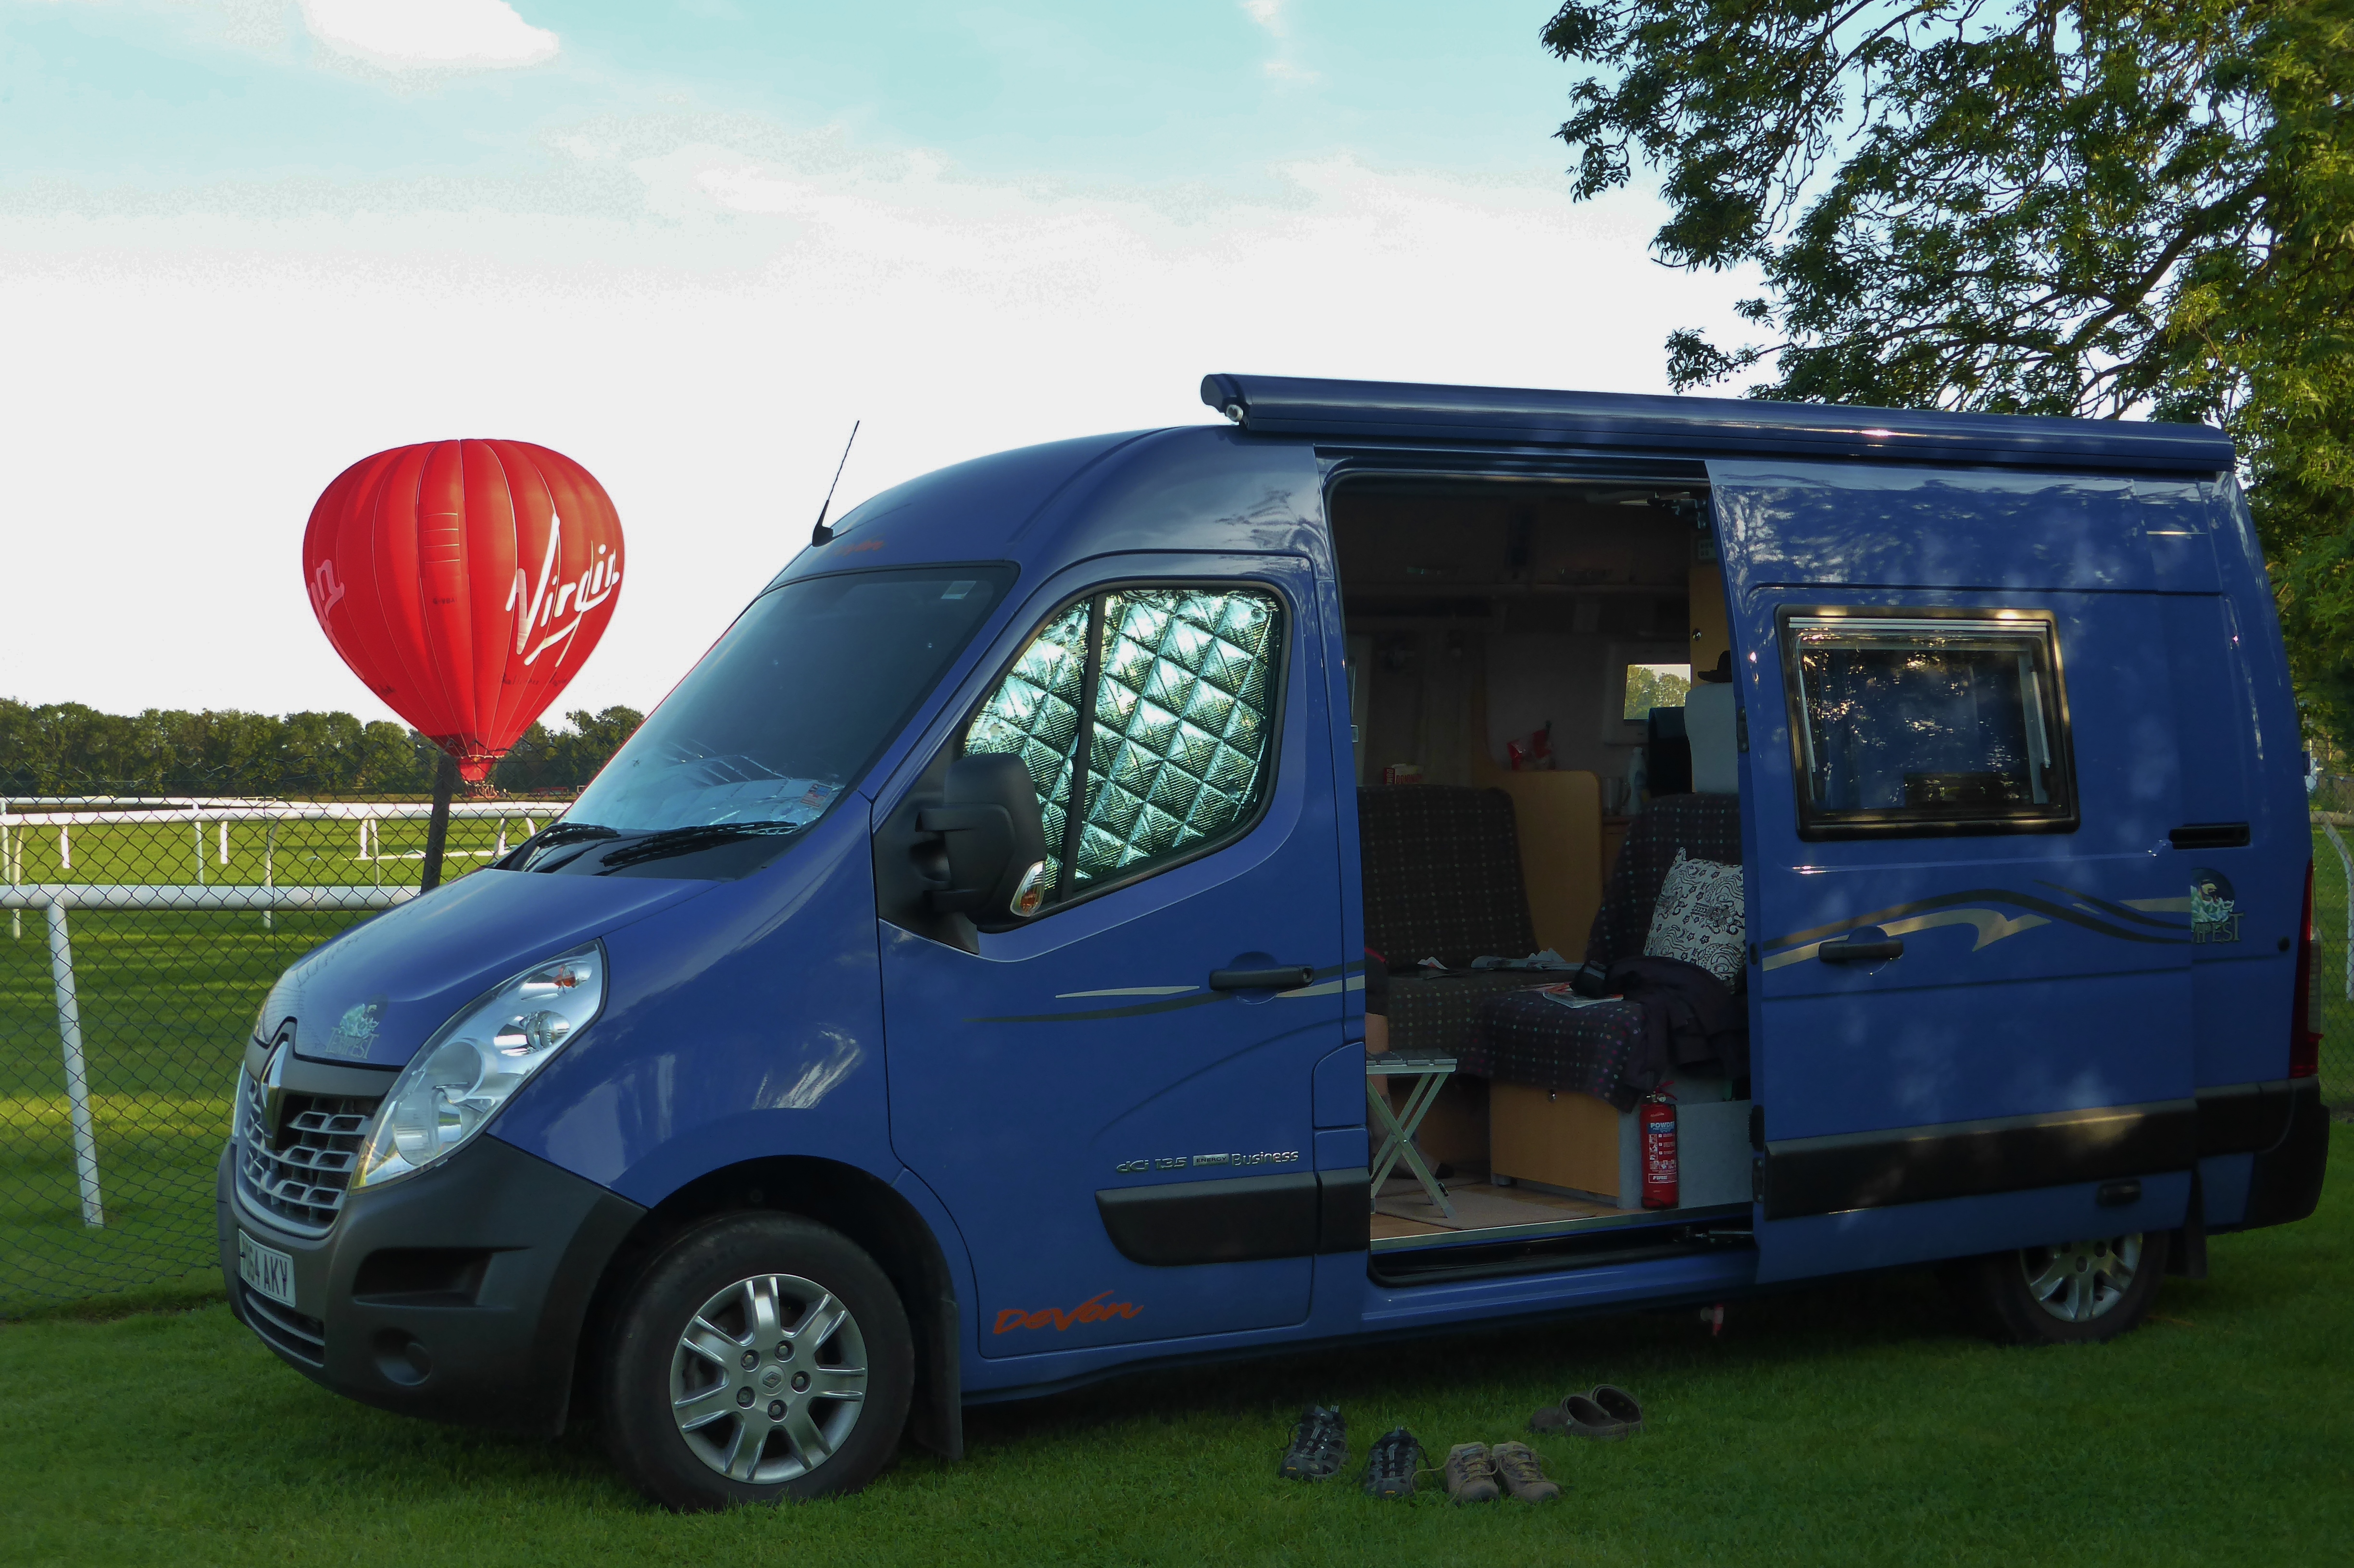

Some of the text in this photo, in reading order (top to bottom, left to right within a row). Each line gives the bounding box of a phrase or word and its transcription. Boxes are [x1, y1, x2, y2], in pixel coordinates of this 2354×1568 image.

[505, 512, 620, 667] Virgin
[1116, 1159, 1149, 1172] dCi
[1155, 1157, 1187, 1169] 135
[1232, 1152, 1299, 1166] Business
[264, 1254, 288, 1297] AKY
